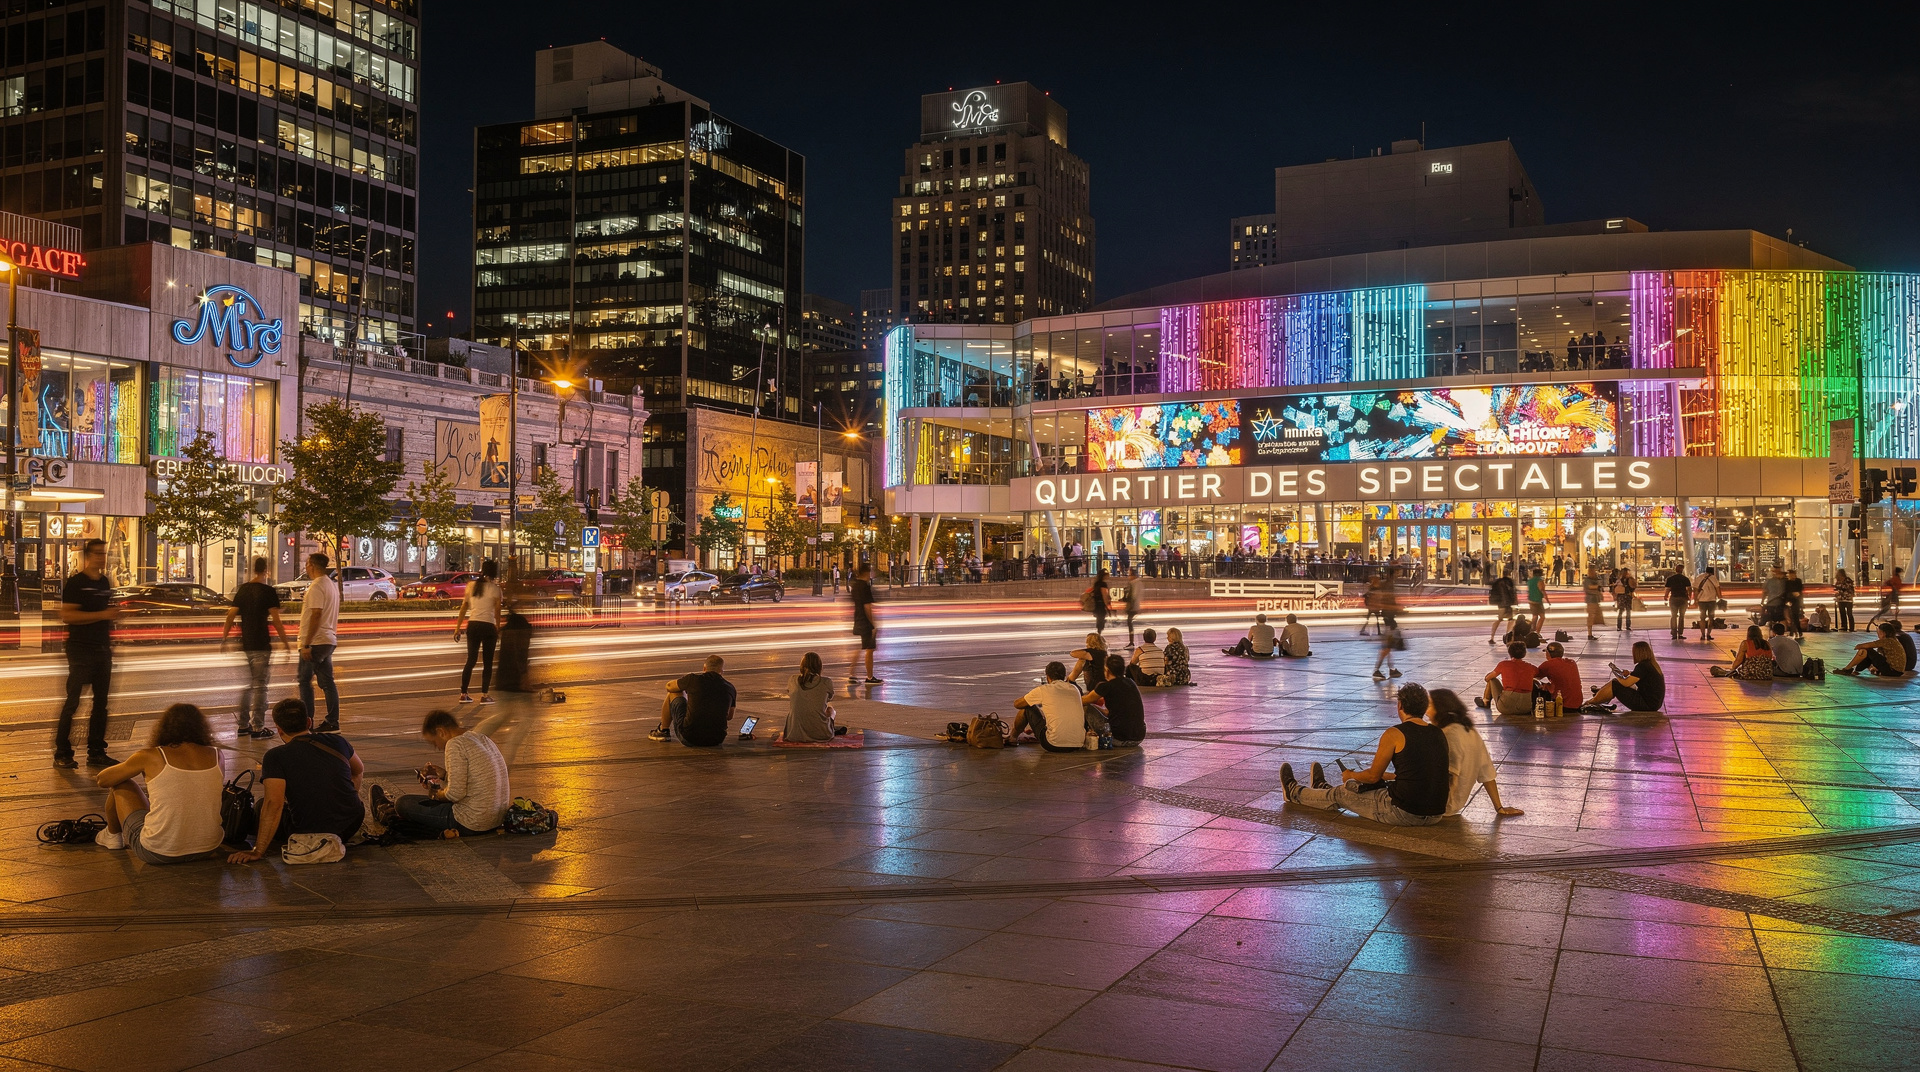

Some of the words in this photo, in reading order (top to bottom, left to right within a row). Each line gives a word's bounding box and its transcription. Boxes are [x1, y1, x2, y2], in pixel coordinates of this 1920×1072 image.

[1035, 473, 1223, 505] QUARTIER
[1250, 469, 1326, 497] DES
[1358, 460, 1652, 494] SPECTALES
